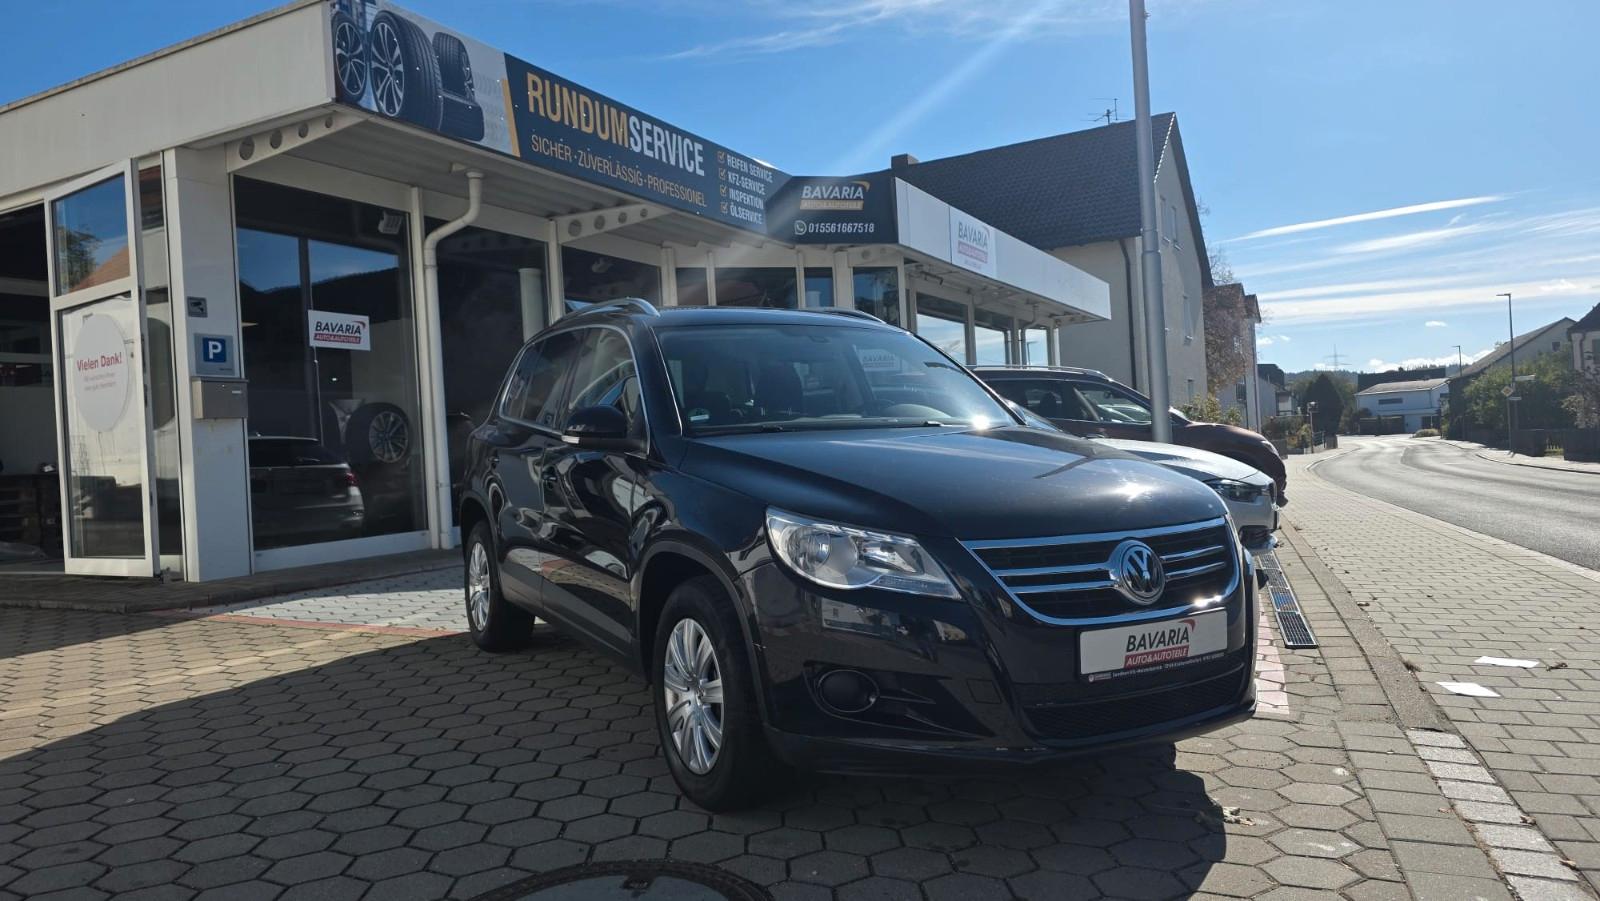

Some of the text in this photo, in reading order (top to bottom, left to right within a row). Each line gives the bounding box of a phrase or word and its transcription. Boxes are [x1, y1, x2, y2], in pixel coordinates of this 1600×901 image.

[527, 72, 705, 176] RUNDUMSERVICE
[531, 134, 573, 163] SICHER
[577, 150, 644, 187] ZUVERLÄSSIG
[727, 154, 773, 183] REIFEN SERVICE
[727, 171, 766, 195] KFZ-SERVICE
[801, 185, 864, 199] BAVARIA
[728, 188, 764, 210] INSPEKTION
[729, 202, 763, 225] ÖLSERVICE
[808, 222, 875, 233] 015561667518
[958, 222, 988, 249] BAVARIA
[315, 321, 362, 335] BAVARIA
[208, 340, 222, 360] P
[76, 352, 122, 372] Vielen Dank!
[1126, 627, 1190, 653] BAVARIA
